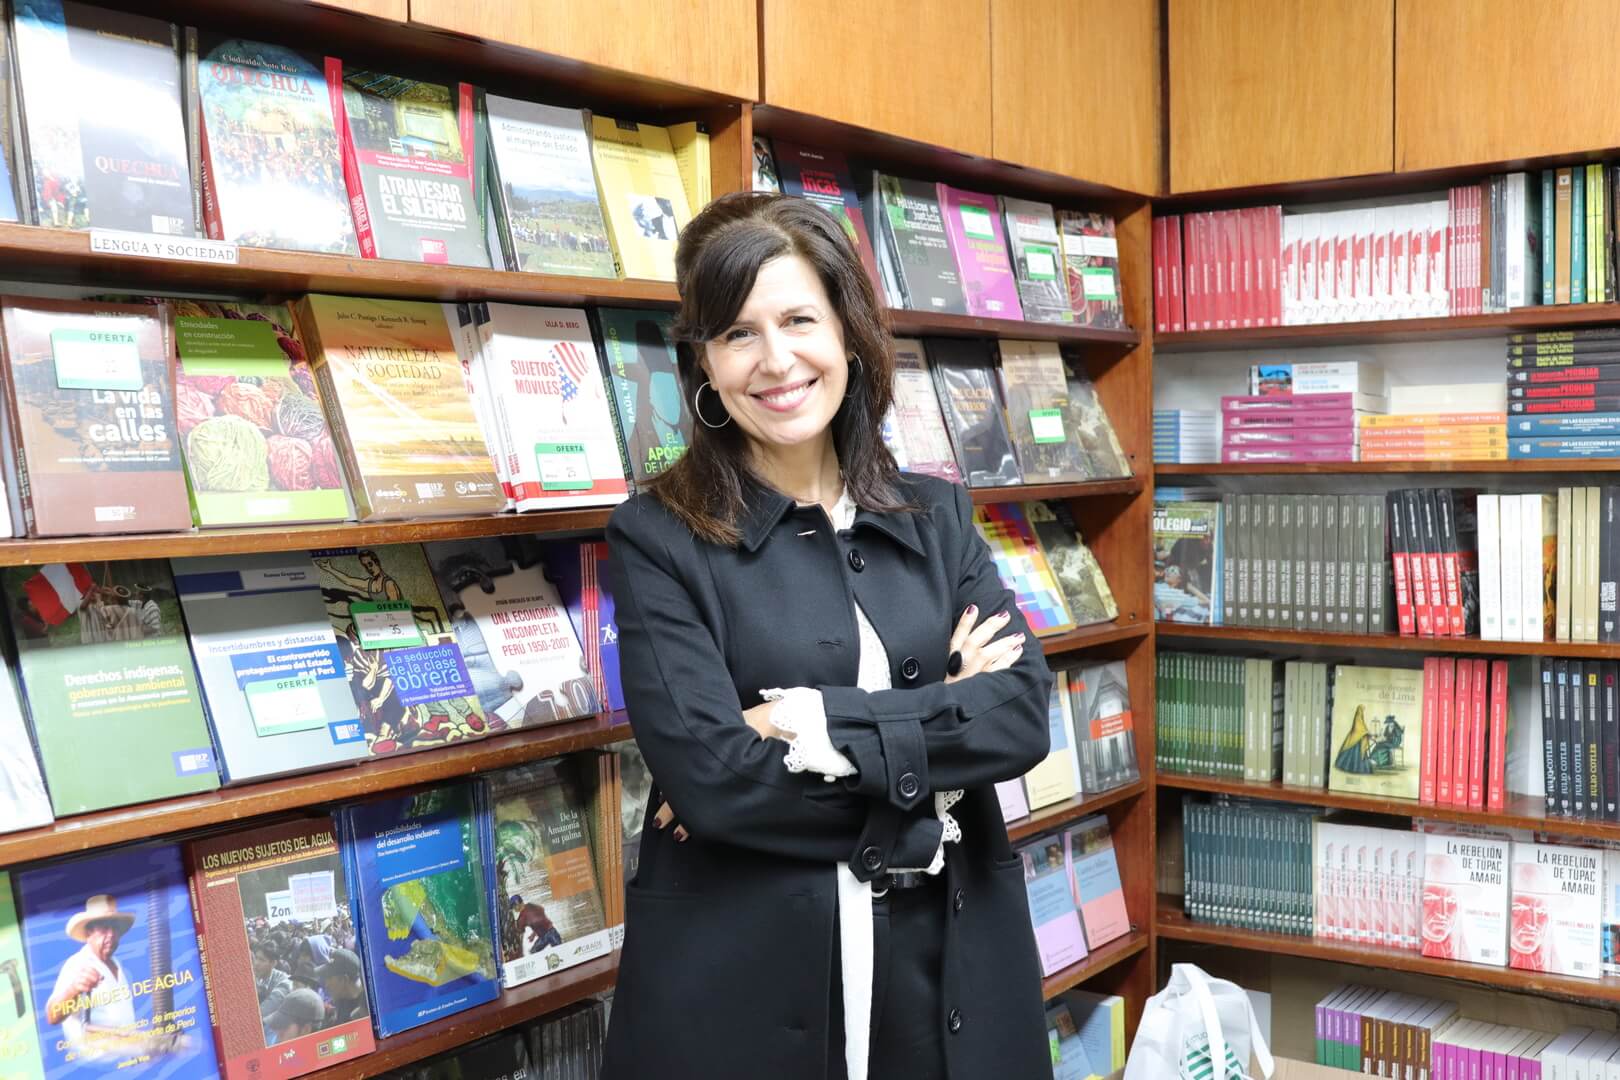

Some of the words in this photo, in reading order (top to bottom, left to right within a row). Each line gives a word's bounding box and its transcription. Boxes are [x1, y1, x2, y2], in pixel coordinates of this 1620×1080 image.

[210, 63, 315, 96] QUECHUA
[95, 155, 181, 179] QUECHUA
[378, 174, 463, 203] ATRAVESAR
[381, 193, 402, 216] EL
[400, 198, 467, 222] SILENCIO
[94, 238, 150, 254] LENGUA
[154, 243, 163, 254] Y
[168, 245, 235, 261] SOCIEDAD
[89, 333, 134, 344] OFERTA
[344, 344, 441, 362] NATURALEZA
[366, 363, 442, 379] SOCIEDAD
[510, 359, 557, 377] SUJETOS
[92, 389, 114, 404] La
[124, 389, 162, 405] vida
[115, 405, 136, 419] en
[140, 402, 163, 419] las
[88, 417, 167, 442] calles
[666, 432, 677, 443] EL
[556, 445, 584, 453] OFERTA
[645, 461, 658, 474] DE
[1153, 517, 1191, 532] OLEGIO
[376, 602, 410, 611] OFERTA
[491, 611, 511, 625] UNA
[513, 604, 560, 622] ECONOMÍA
[502, 622, 560, 641] INCOMPLETA
[276, 641, 283, 651] y
[284, 633, 326, 646] distancias
[502, 642, 526, 657] PERÚ
[528, 636, 571, 652] 1950-2007
[266, 655, 276, 664] El
[276, 649, 330, 663] controvertido
[389, 655, 402, 665] La
[404, 648, 454, 663] seducción
[236, 664, 293, 678] protagonismo
[293, 662, 305, 671] del
[306, 659, 332, 670] Estado
[317, 666, 336, 676] Perú
[389, 664, 405, 676] de
[409, 661, 421, 673] la
[425, 656, 457, 671] clase
[64, 669, 123, 687] Derechos
[123, 665, 184, 681] indígenas,
[276, 677, 315, 690] OFERTA
[396, 665, 462, 691] obrera
[68, 684, 133, 702] gobernanza
[135, 675, 186, 692] ambiental
[1378, 691, 1390, 700] de
[1391, 690, 1416, 700] Lima
[1546, 740, 1554, 770] COTLER
[559, 812, 569, 822] De
[570, 810, 578, 819] la
[374, 830, 385, 839] Las
[548, 820, 580, 836] Amazonía
[376, 839, 387, 849] del
[387, 833, 415, 847] desarrollo
[551, 836, 561, 845] su
[561, 829, 582, 846] palma
[202, 853, 220, 869] LOS
[221, 846, 254, 867] NUEVOS
[255, 839, 293, 862] SUJETOS
[294, 835, 311, 850] DEL
[311, 831, 334, 848] AGUA
[1447, 841, 1458, 855] LA
[1461, 843, 1502, 859] REBELIÓN
[1462, 857, 1473, 869] DE
[1537, 850, 1549, 864] LA
[1551, 852, 1597, 869] REBELIÓN
[1469, 872, 1502, 885] AMARU
[1553, 867, 1566, 879] DE
[1561, 881, 1596, 896] AMARU
[271, 905, 291, 917] Zon
[52, 985, 132, 1019] PIRÁMIDES
[132, 980, 154, 997] DE
[154, 969, 194, 990] AGUA
[177, 1018, 196, 1031] Perú
[513, 1068, 527, 1080] en
